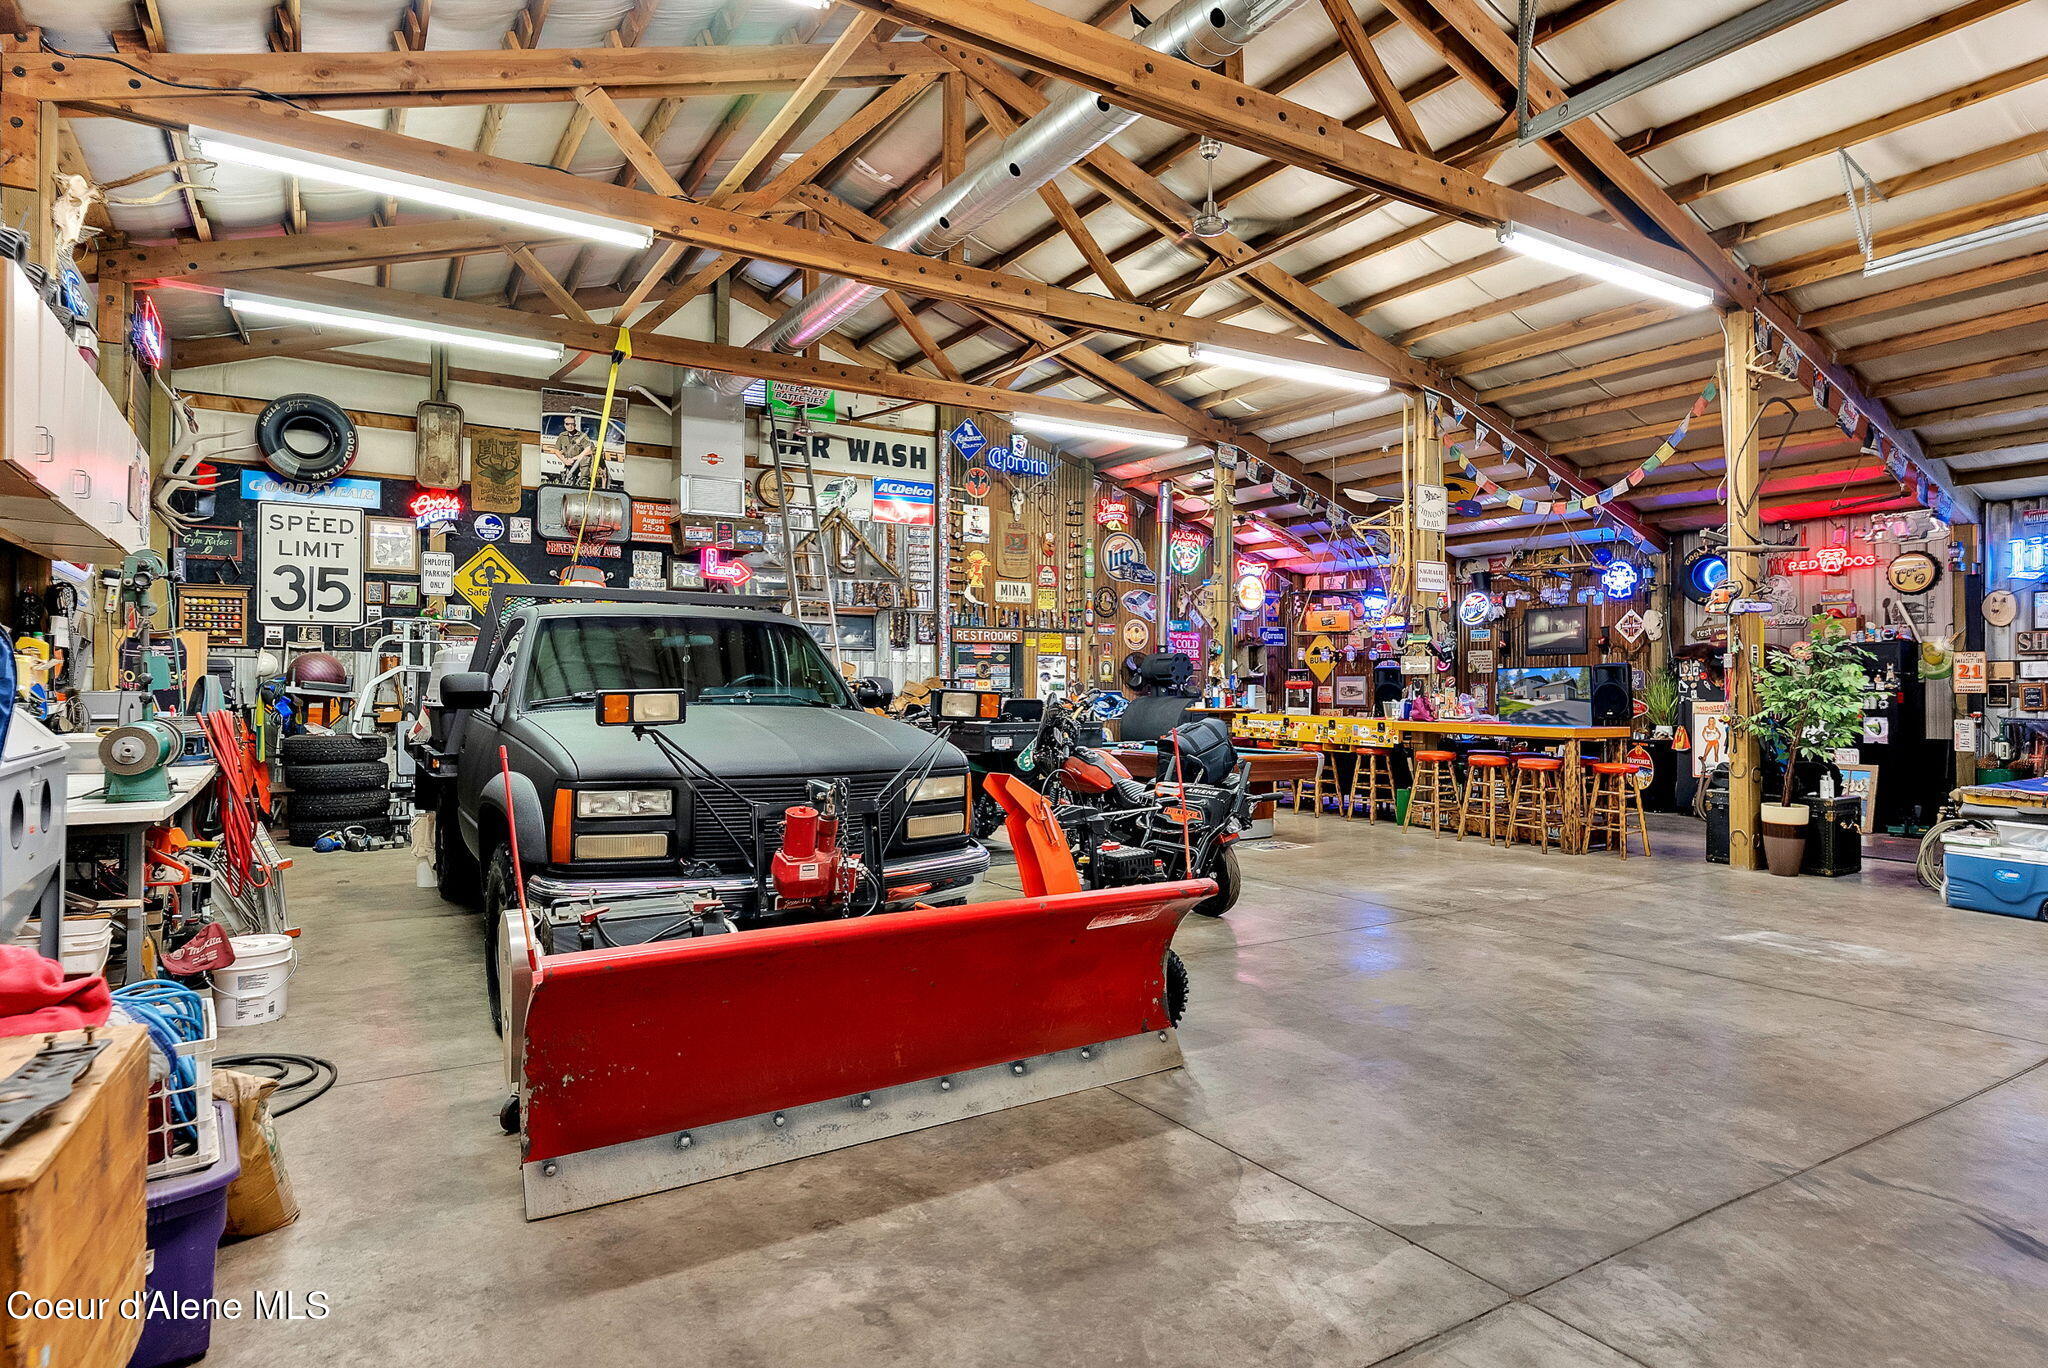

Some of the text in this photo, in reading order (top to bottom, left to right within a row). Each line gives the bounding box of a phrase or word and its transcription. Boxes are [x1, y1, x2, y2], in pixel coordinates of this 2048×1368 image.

[773, 381, 829, 398] INTERATE
[260, 402, 281, 428] EAGLE
[847, 437, 928, 470] WASH
[988, 446, 1049, 476] Corona
[877, 482, 933, 498] ACDelco
[410, 494, 461, 516] Coors
[634, 503, 654, 512] North
[1417, 504, 1446, 519] CHINOOK
[269, 513, 355, 535] SPEED
[416, 508, 460, 530] LIGHT
[642, 517, 666, 526] August
[1422, 518, 1441, 528] TRAIL
[642, 524, 666, 533] 25-29
[182, 534, 204, 547] Gym
[1171, 530, 1204, 546] ALASKAN
[278, 539, 345, 559] LIMIT
[424, 558, 451, 567] EMPLOYEE
[1107, 548, 1134, 572] Lite
[1787, 554, 1876, 572] RED DOG
[424, 569, 451, 578] PARKING
[269, 564, 352, 613] 35
[1000, 584, 1027, 598] MINA
[956, 630, 1019, 642] RESTROOMS
[1261, 630, 1285, 642] Corona
[1696, 627, 1712, 637] rest
[1175, 639, 1200, 650] COLD
[1957, 664, 1983, 680] 21
